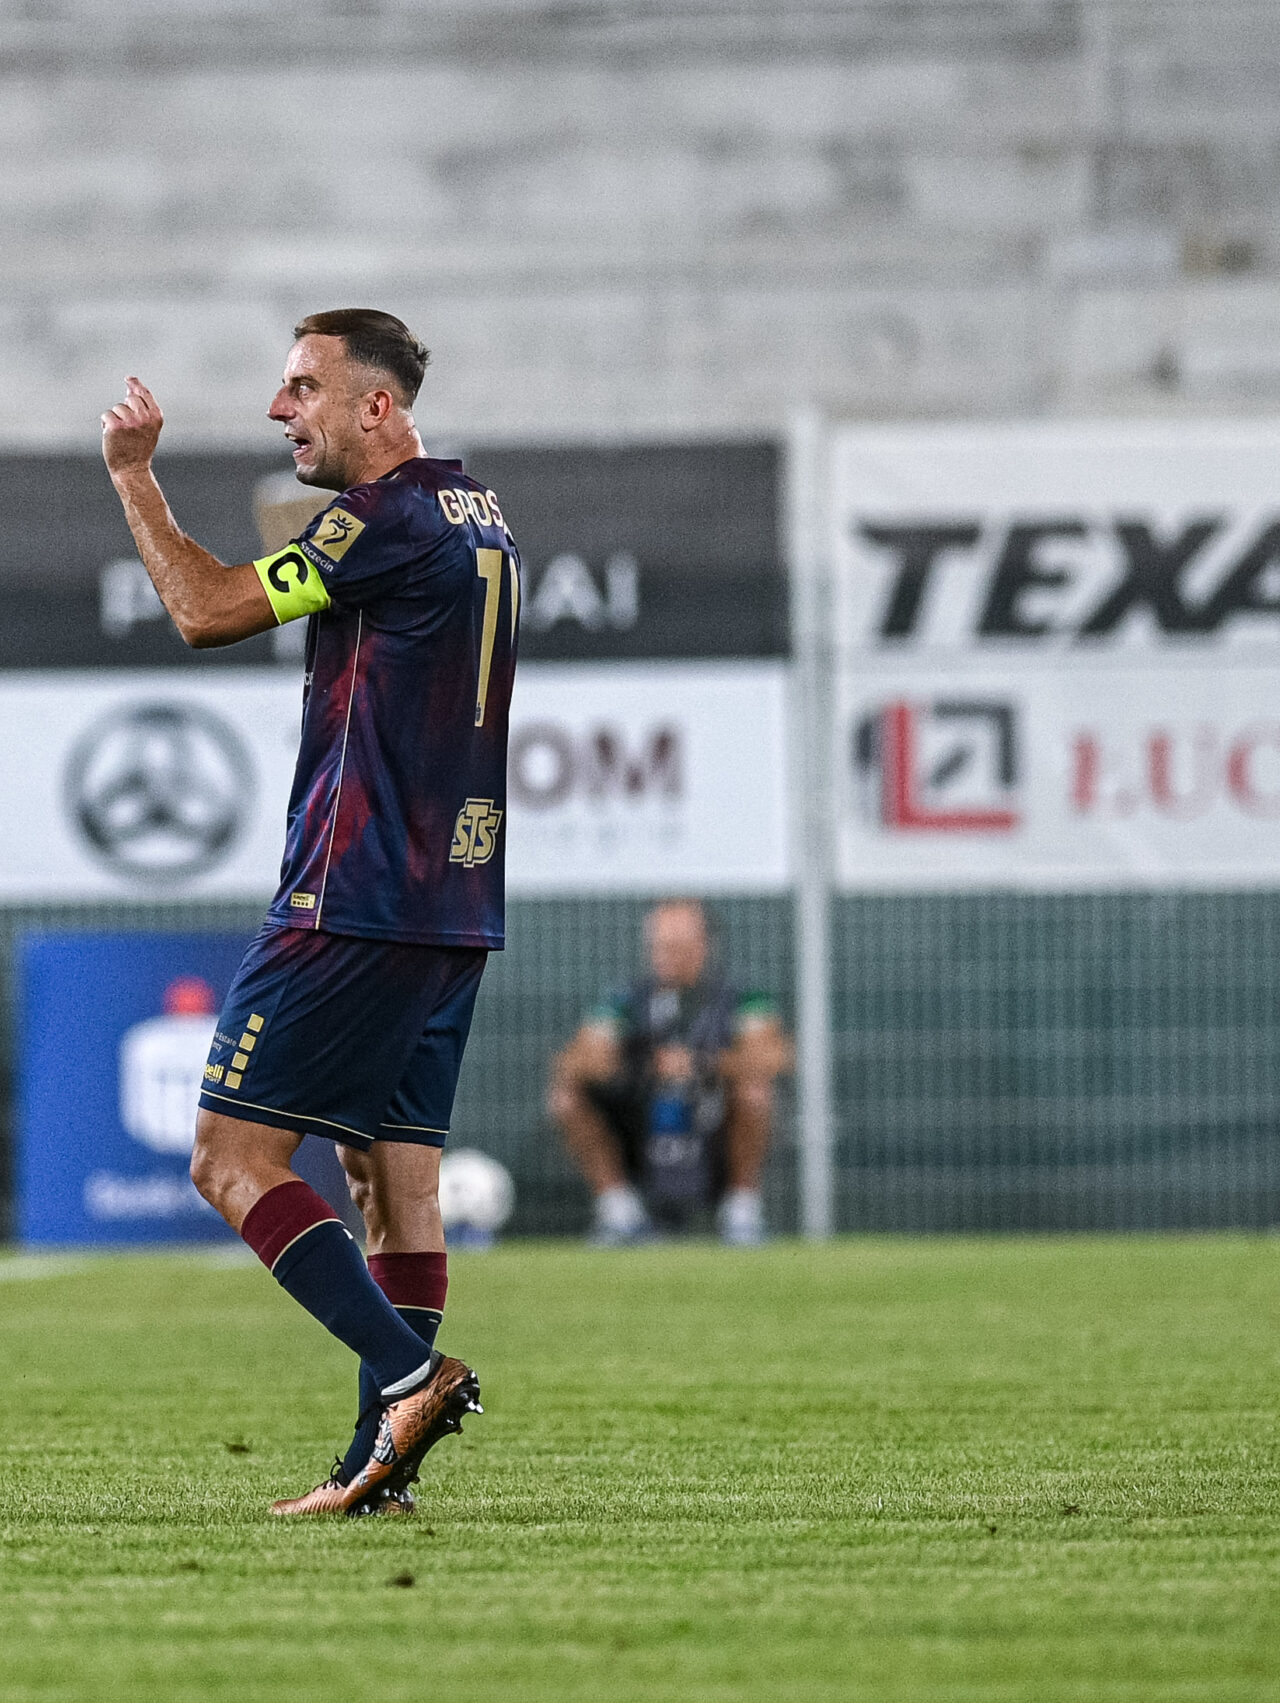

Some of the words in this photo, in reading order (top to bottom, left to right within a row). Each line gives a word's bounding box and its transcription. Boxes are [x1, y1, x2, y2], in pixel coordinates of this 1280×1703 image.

[437, 488, 514, 544] GROS
[267, 551, 309, 593] C
[300, 541, 334, 572] Szczecin
[449, 798, 504, 868] STS
